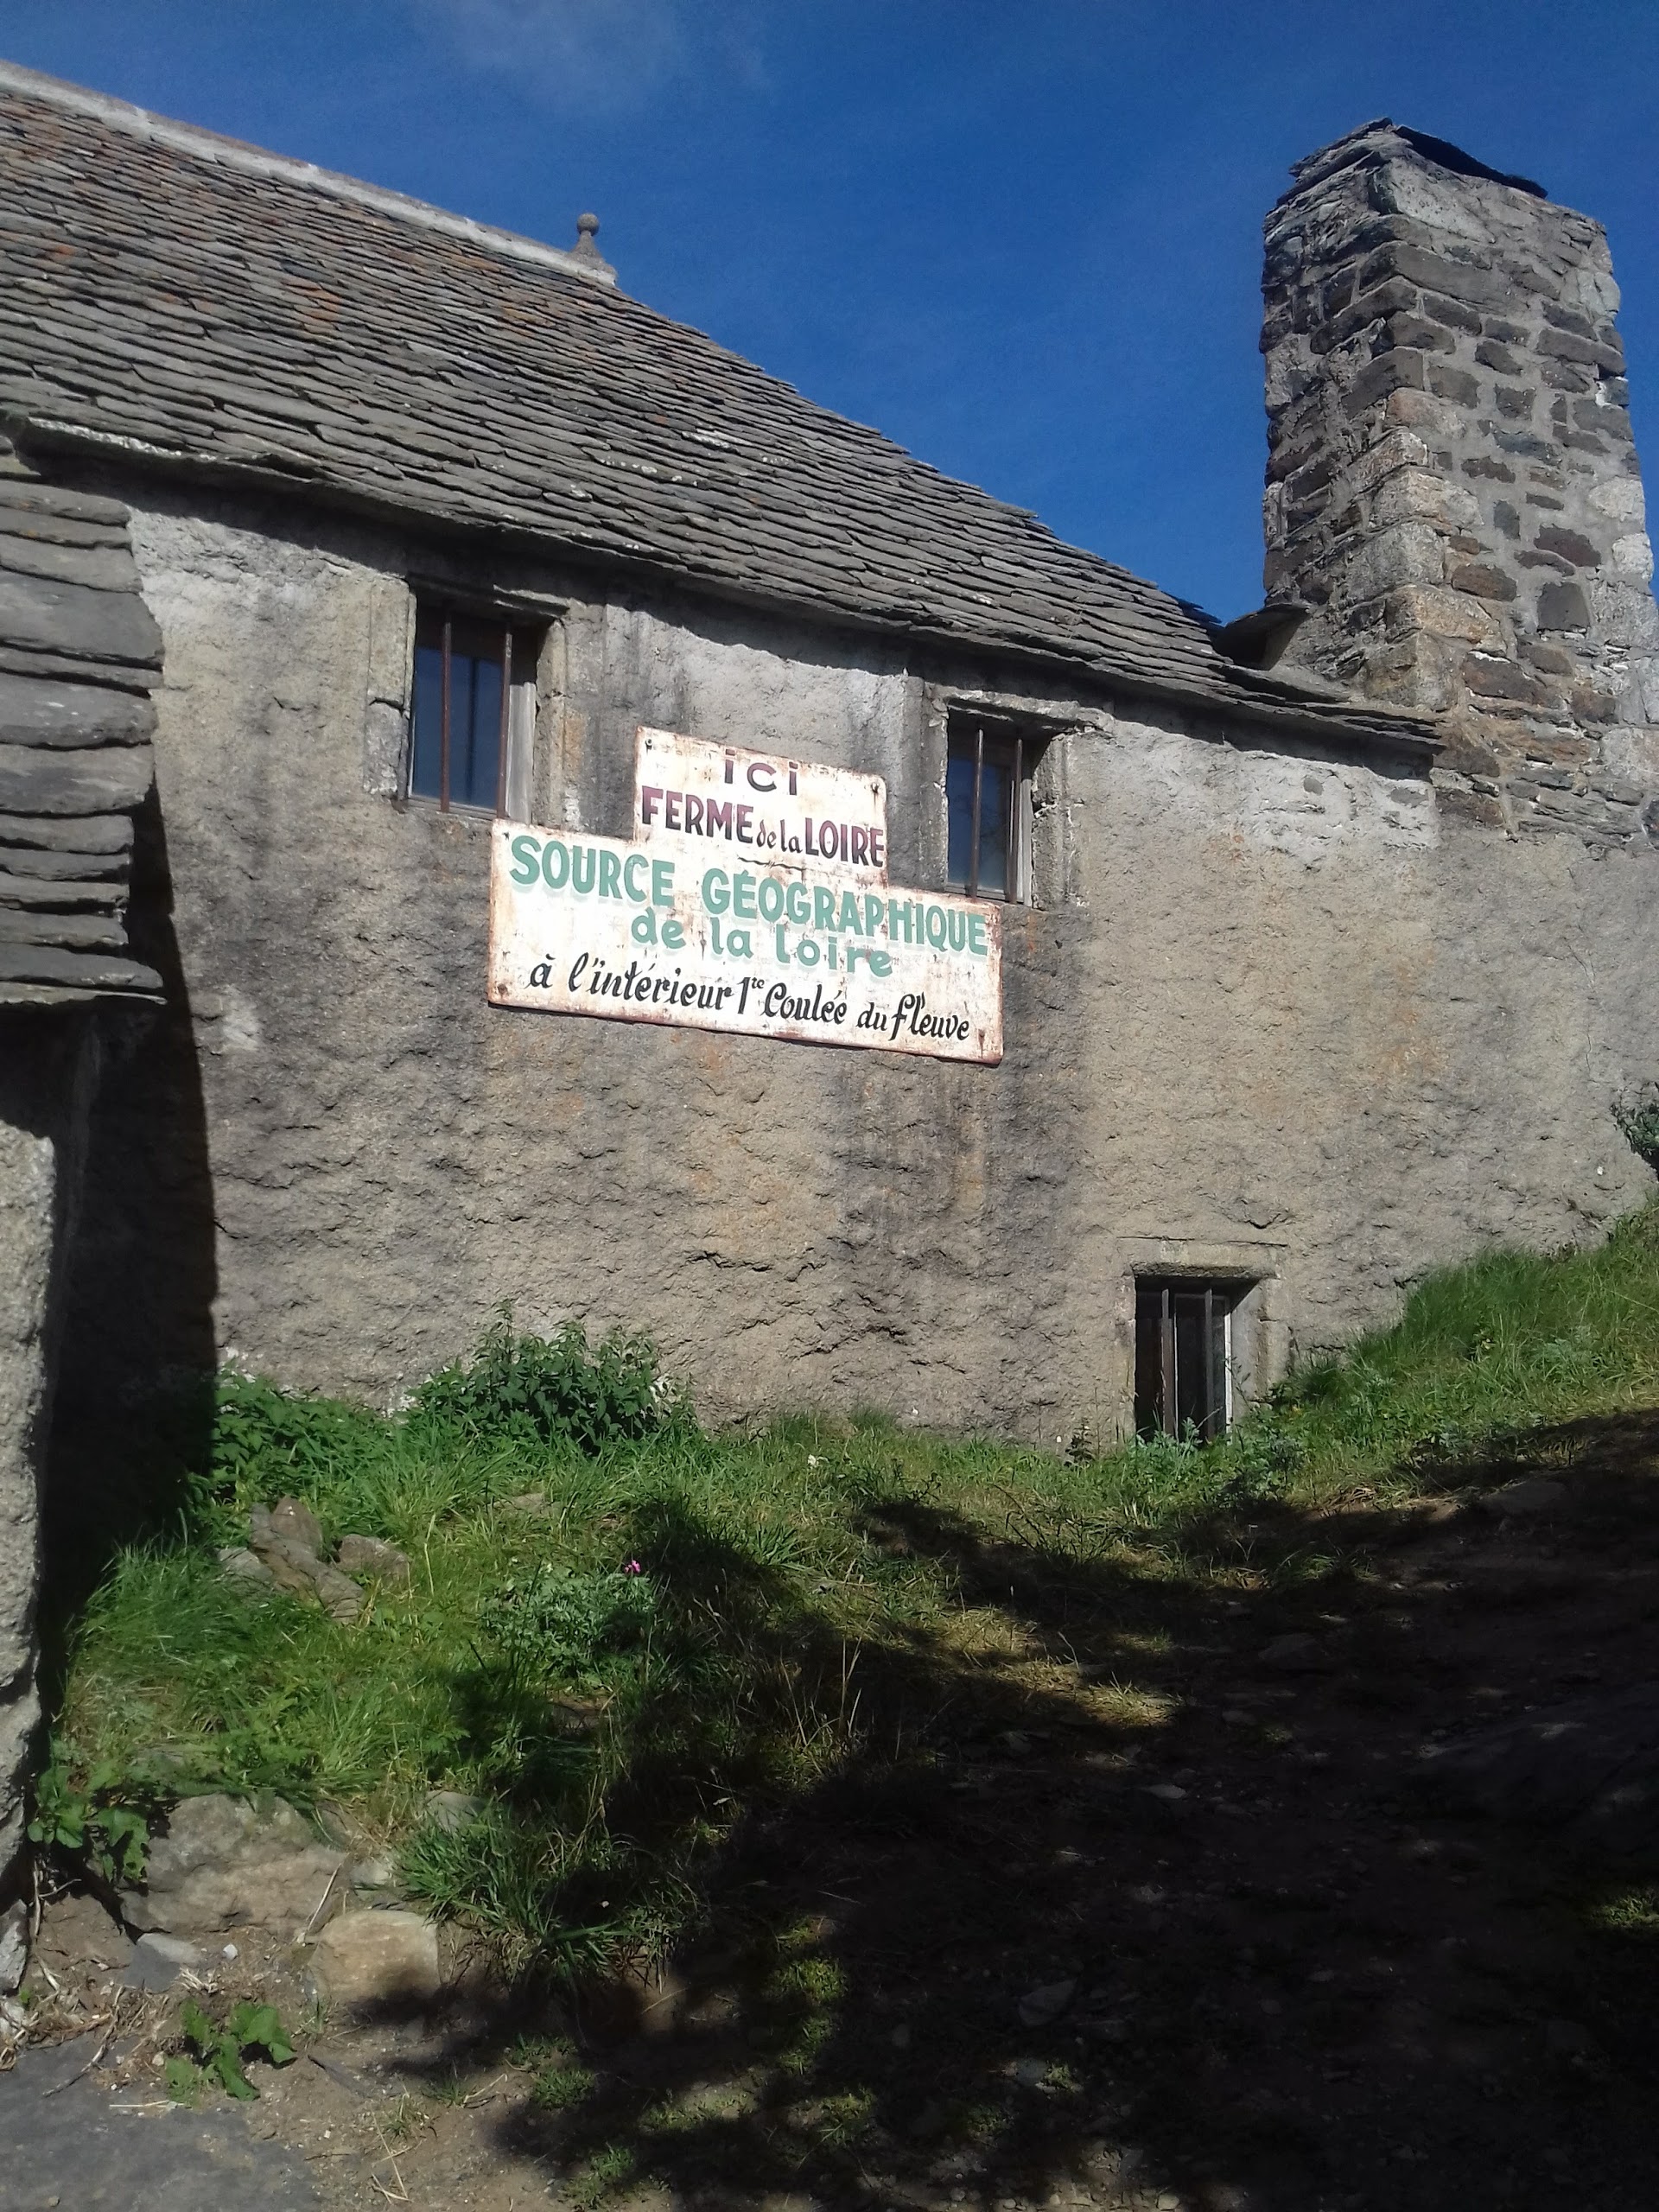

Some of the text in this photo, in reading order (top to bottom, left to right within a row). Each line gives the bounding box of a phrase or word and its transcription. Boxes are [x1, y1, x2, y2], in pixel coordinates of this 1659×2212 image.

[641, 785, 886, 868] FERME de la LOIRE
[509, 835, 988, 957] SOURCE GÉOGRAPHIQUE
[631, 906, 686, 950] de
[709, 916, 754, 959] la
[524, 953, 556, 989] à
[760, 982, 848, 1025] Coulée
[855, 1001, 888, 1032] du
